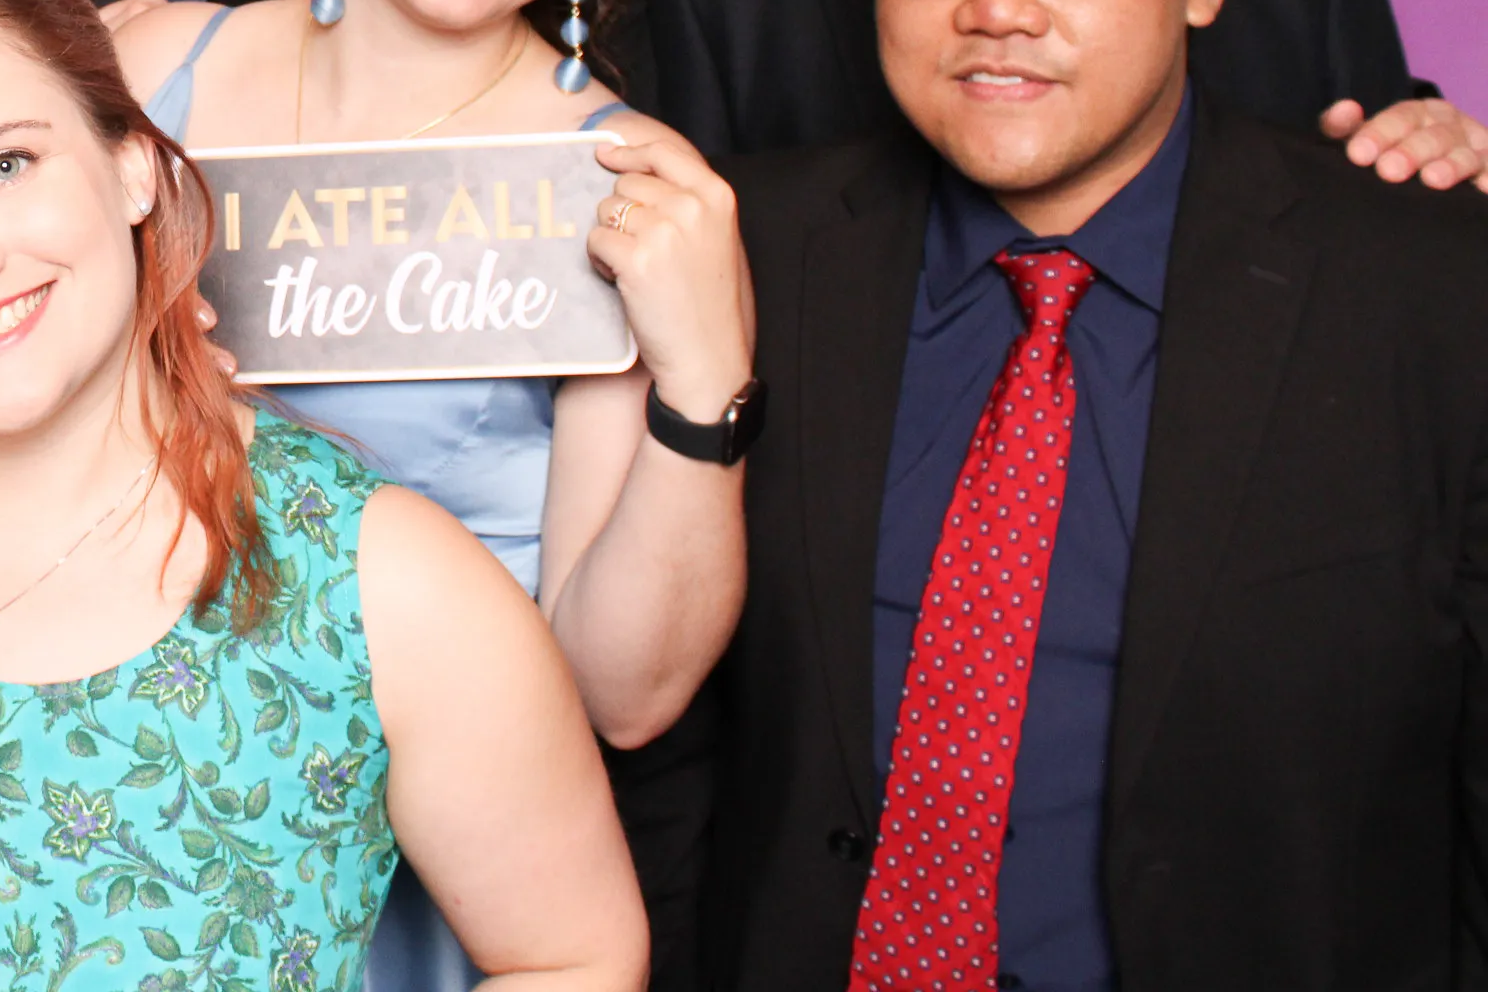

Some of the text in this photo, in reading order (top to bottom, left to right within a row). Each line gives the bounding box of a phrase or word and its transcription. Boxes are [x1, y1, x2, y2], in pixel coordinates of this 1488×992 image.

[224, 179, 577, 251] I ATE ALL
[264, 249, 557, 338] the Cake
